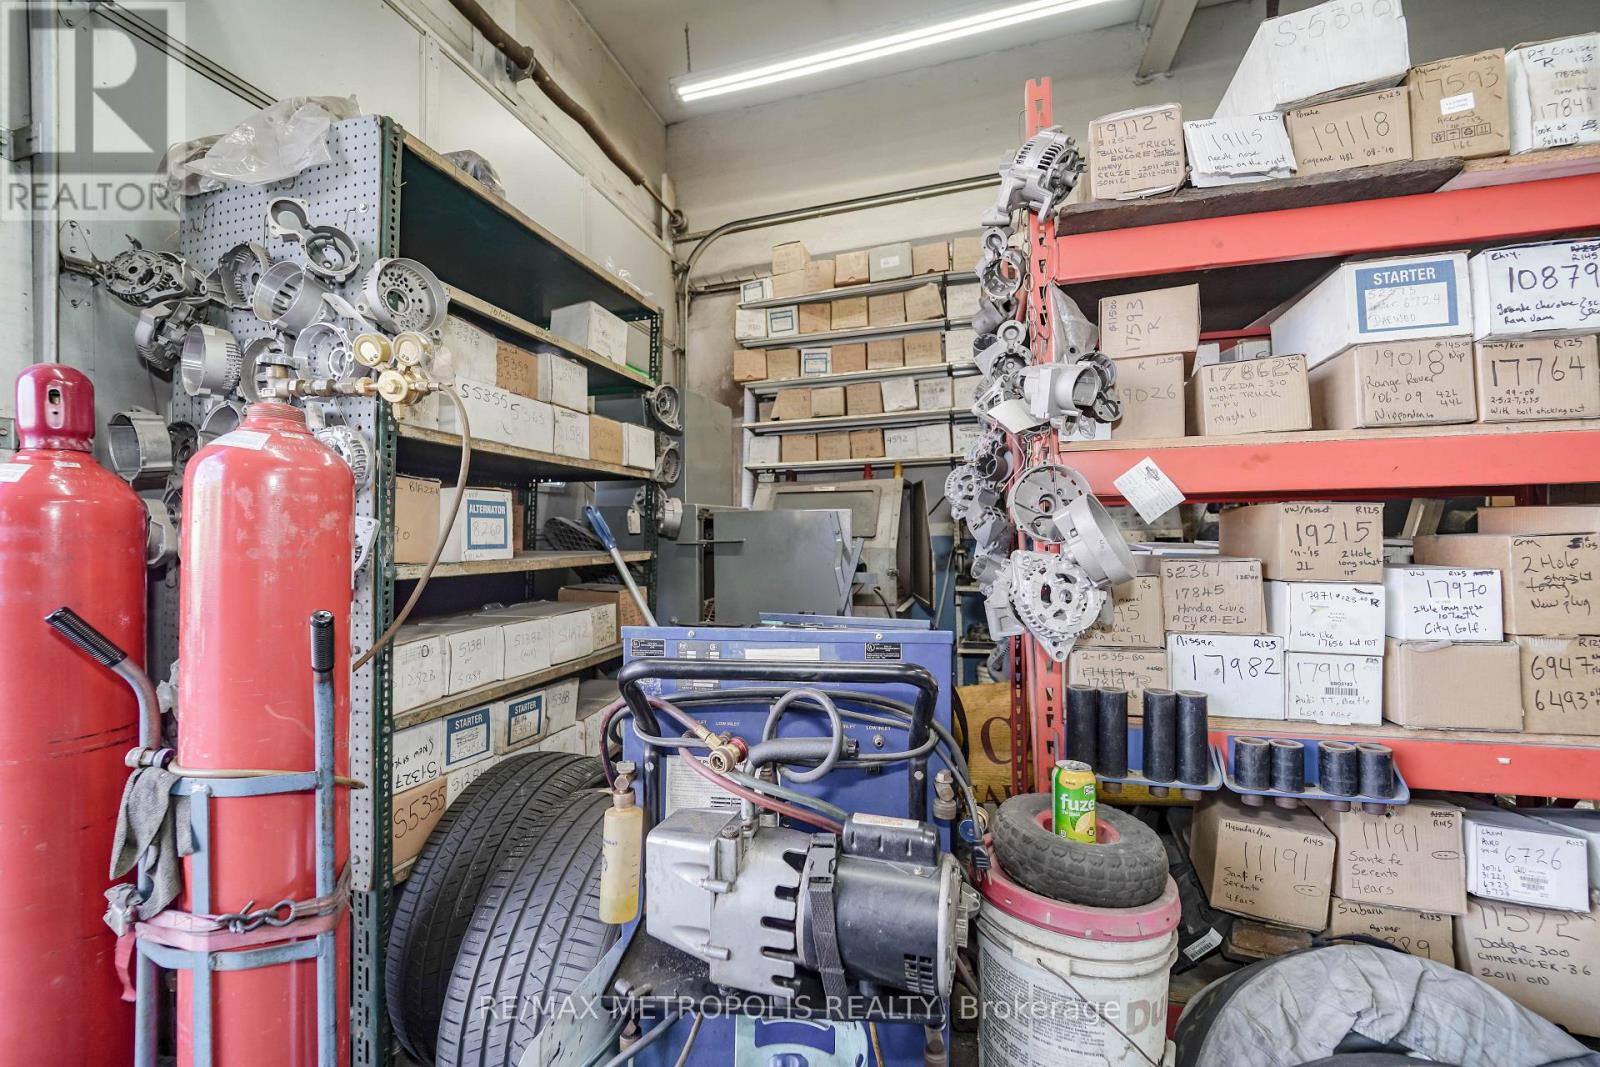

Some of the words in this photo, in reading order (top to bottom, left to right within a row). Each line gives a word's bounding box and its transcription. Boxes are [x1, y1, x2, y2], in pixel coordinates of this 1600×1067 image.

[1373, 267, 1436, 285] STARTER
[1491, 355, 1585, 387] 17764
[469, 504, 506, 515] ALTERNATOR
[1296, 521, 1373, 547] 19215
[1192, 654, 1281, 684] 17982
[1531, 655, 1594, 680] 6947
[515, 701, 537, 715] STARTER
[1536, 689, 1588, 713] 6493
[455, 714, 483, 730] STARTER
[1060, 793, 1095, 812] fuze
